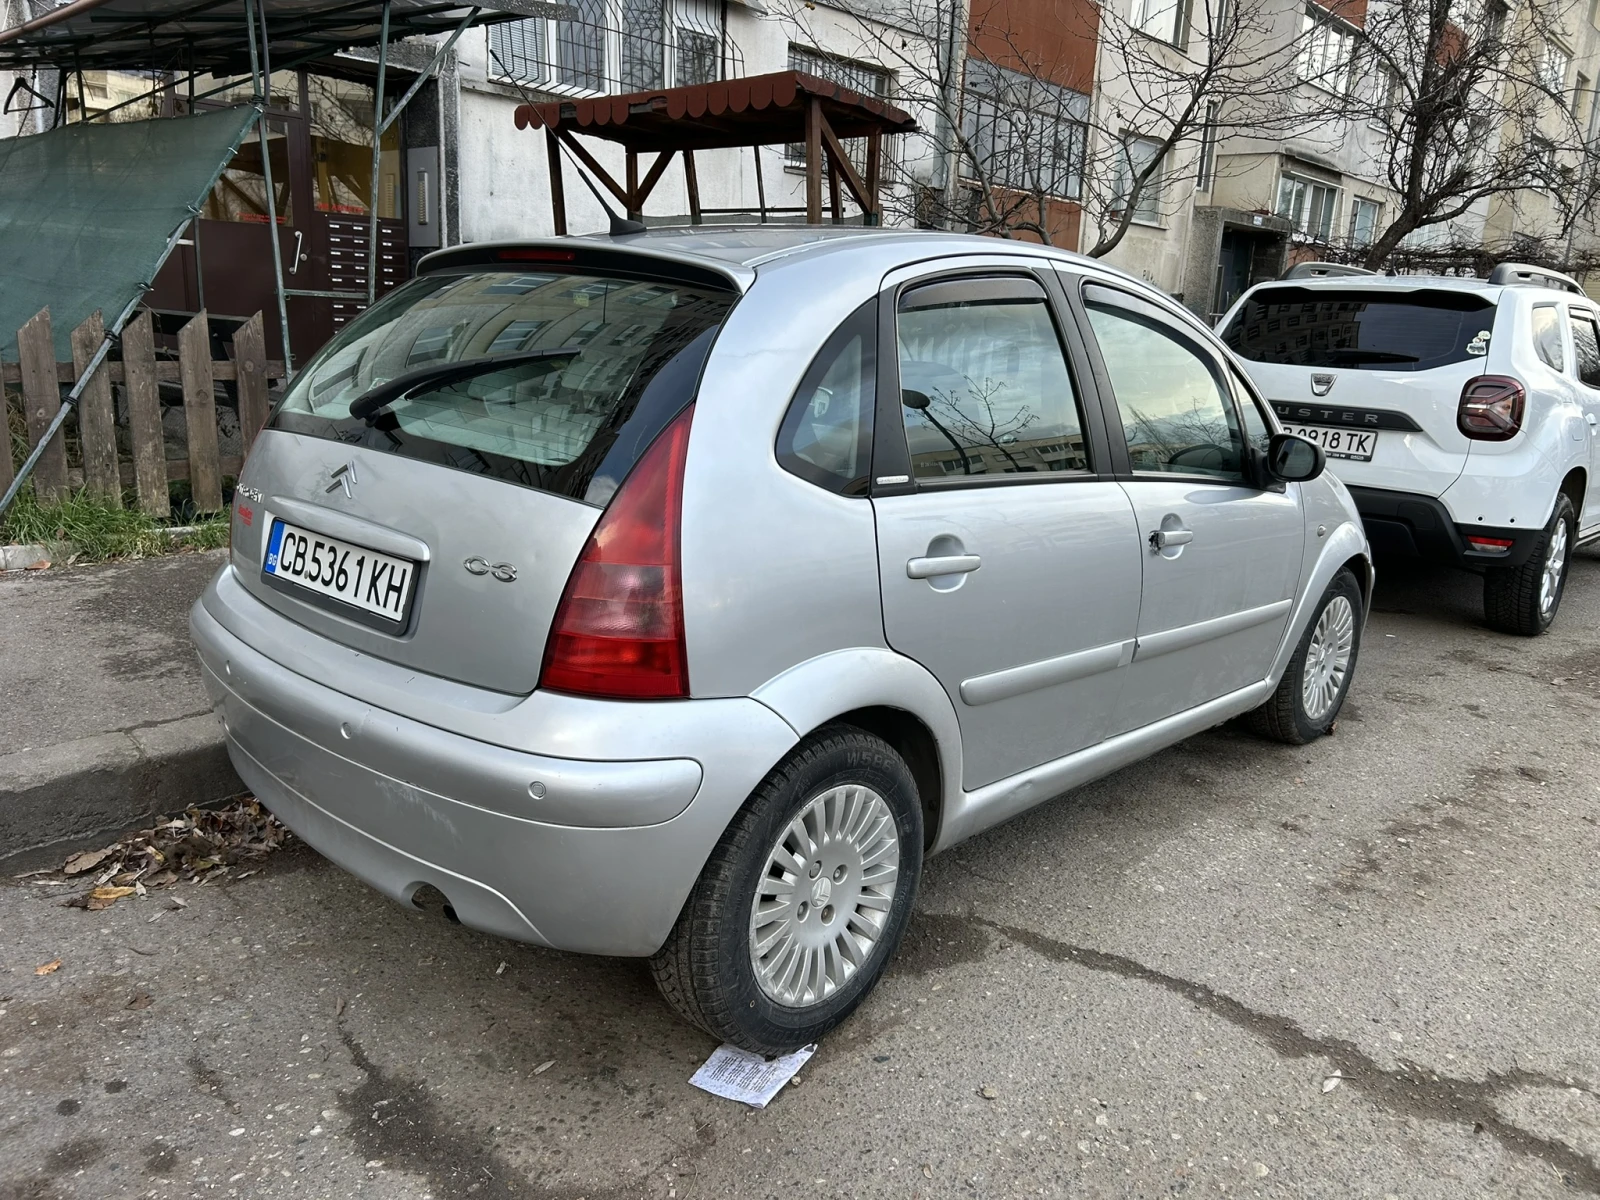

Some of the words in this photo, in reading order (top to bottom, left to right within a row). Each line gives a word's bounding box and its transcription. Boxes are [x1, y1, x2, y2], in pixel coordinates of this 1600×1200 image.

[1277, 406, 1378, 423] USTER
[1346, 432, 1371, 453] TK
[267, 552, 278, 566] BG
[463, 555, 518, 583] C3
